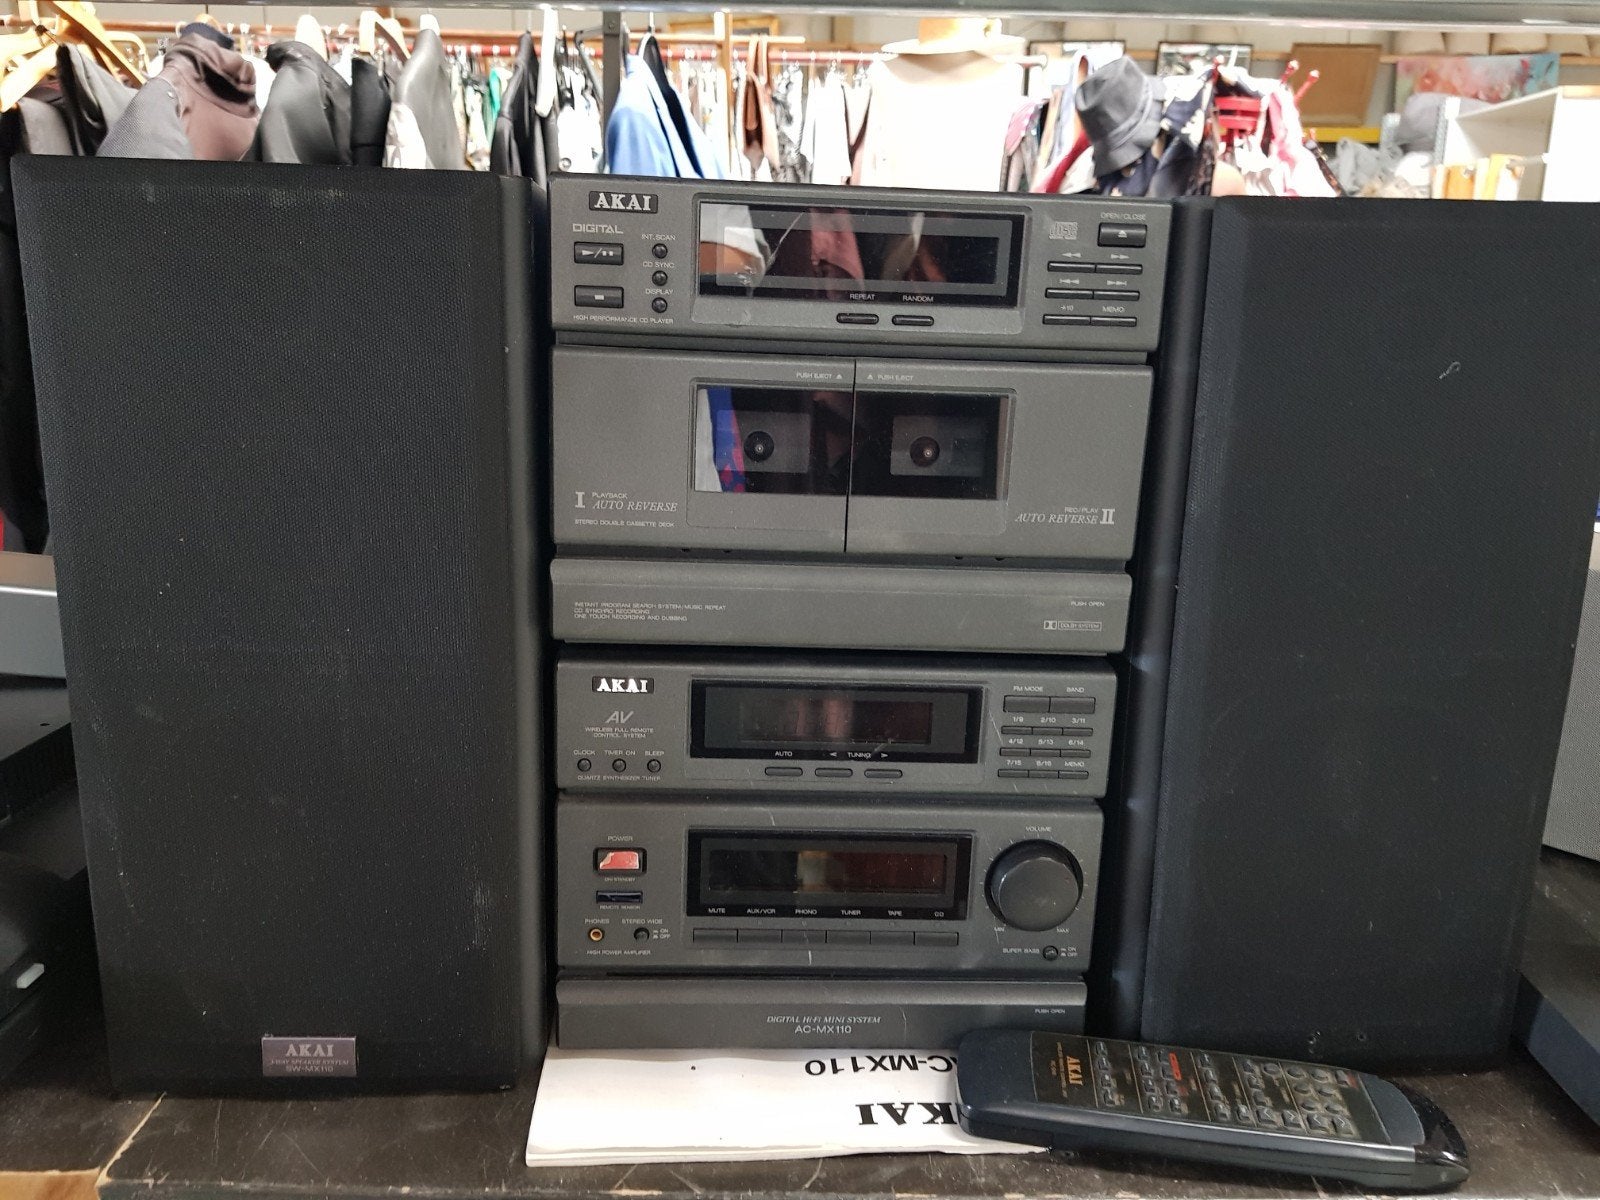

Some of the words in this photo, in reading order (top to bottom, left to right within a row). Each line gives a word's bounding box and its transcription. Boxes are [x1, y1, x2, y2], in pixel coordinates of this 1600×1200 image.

[594, 192, 652, 211] AKAI
[572, 223, 624, 234] DIGITAL
[850, 293, 876, 301] REPEAT
[902, 295, 934, 303] RANDOM
[589, 315, 638, 323] PERFORMANCE
[592, 500, 624, 510] AUTO
[627, 501, 678, 512] REVERSE
[1015, 512, 1046, 523] AUTO
[1049, 513, 1099, 525] REVERSE
[597, 678, 648, 693] AKAI
[605, 711, 634, 724] AV
[847, 751, 871, 759] TUNING
[766, 1016, 800, 1024] DIGITAL
[823, 1016, 845, 1024] MINI
[846, 1016, 881, 1024] SYSTEM
[794, 1025, 852, 1034] AC-MX110
[285, 1044, 334, 1057] AKAI
[1066, 1056, 1084, 1086] AKAI
